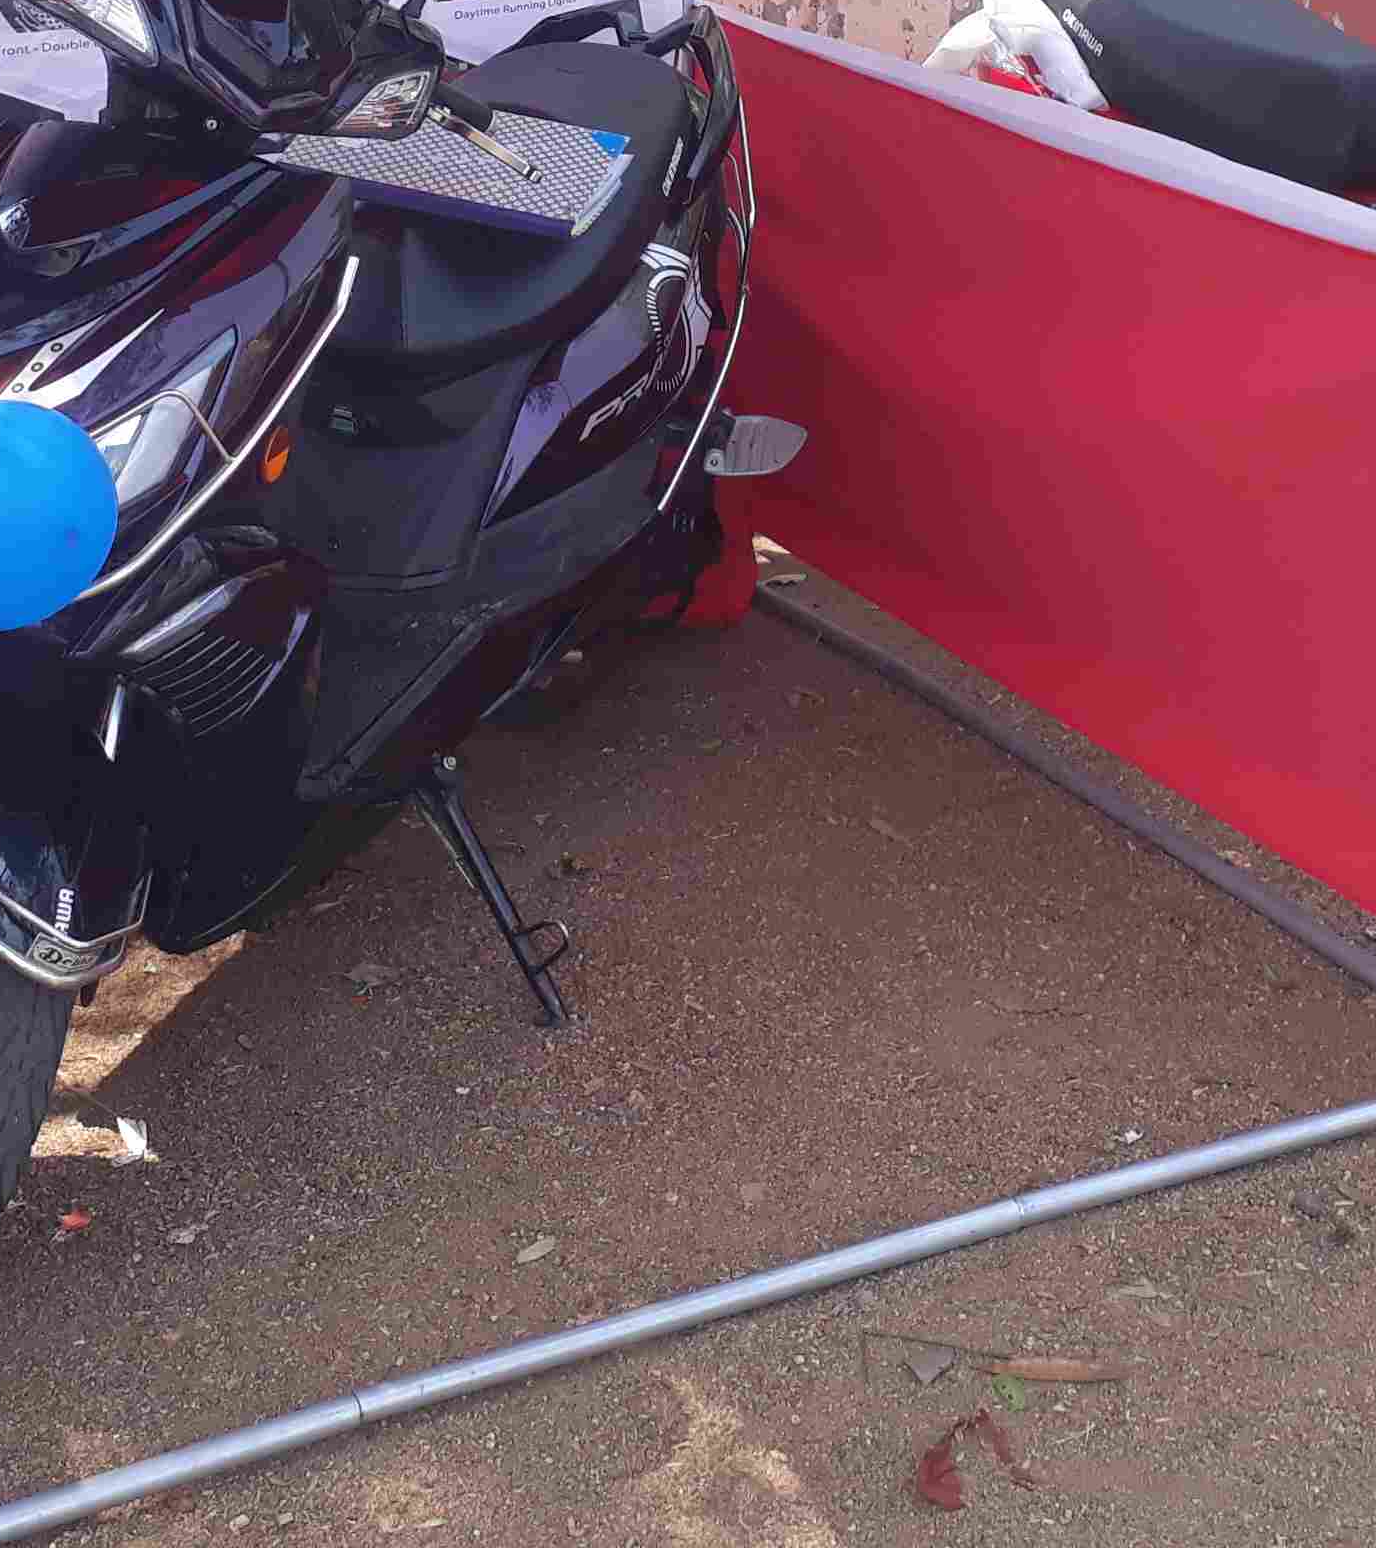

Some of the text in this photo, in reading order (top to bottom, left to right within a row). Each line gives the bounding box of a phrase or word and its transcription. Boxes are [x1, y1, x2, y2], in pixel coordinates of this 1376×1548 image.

[454, 7, 500, 20] Daytime
[503, 0, 546, 13] Running
[41, 40, 91, 53] Double
